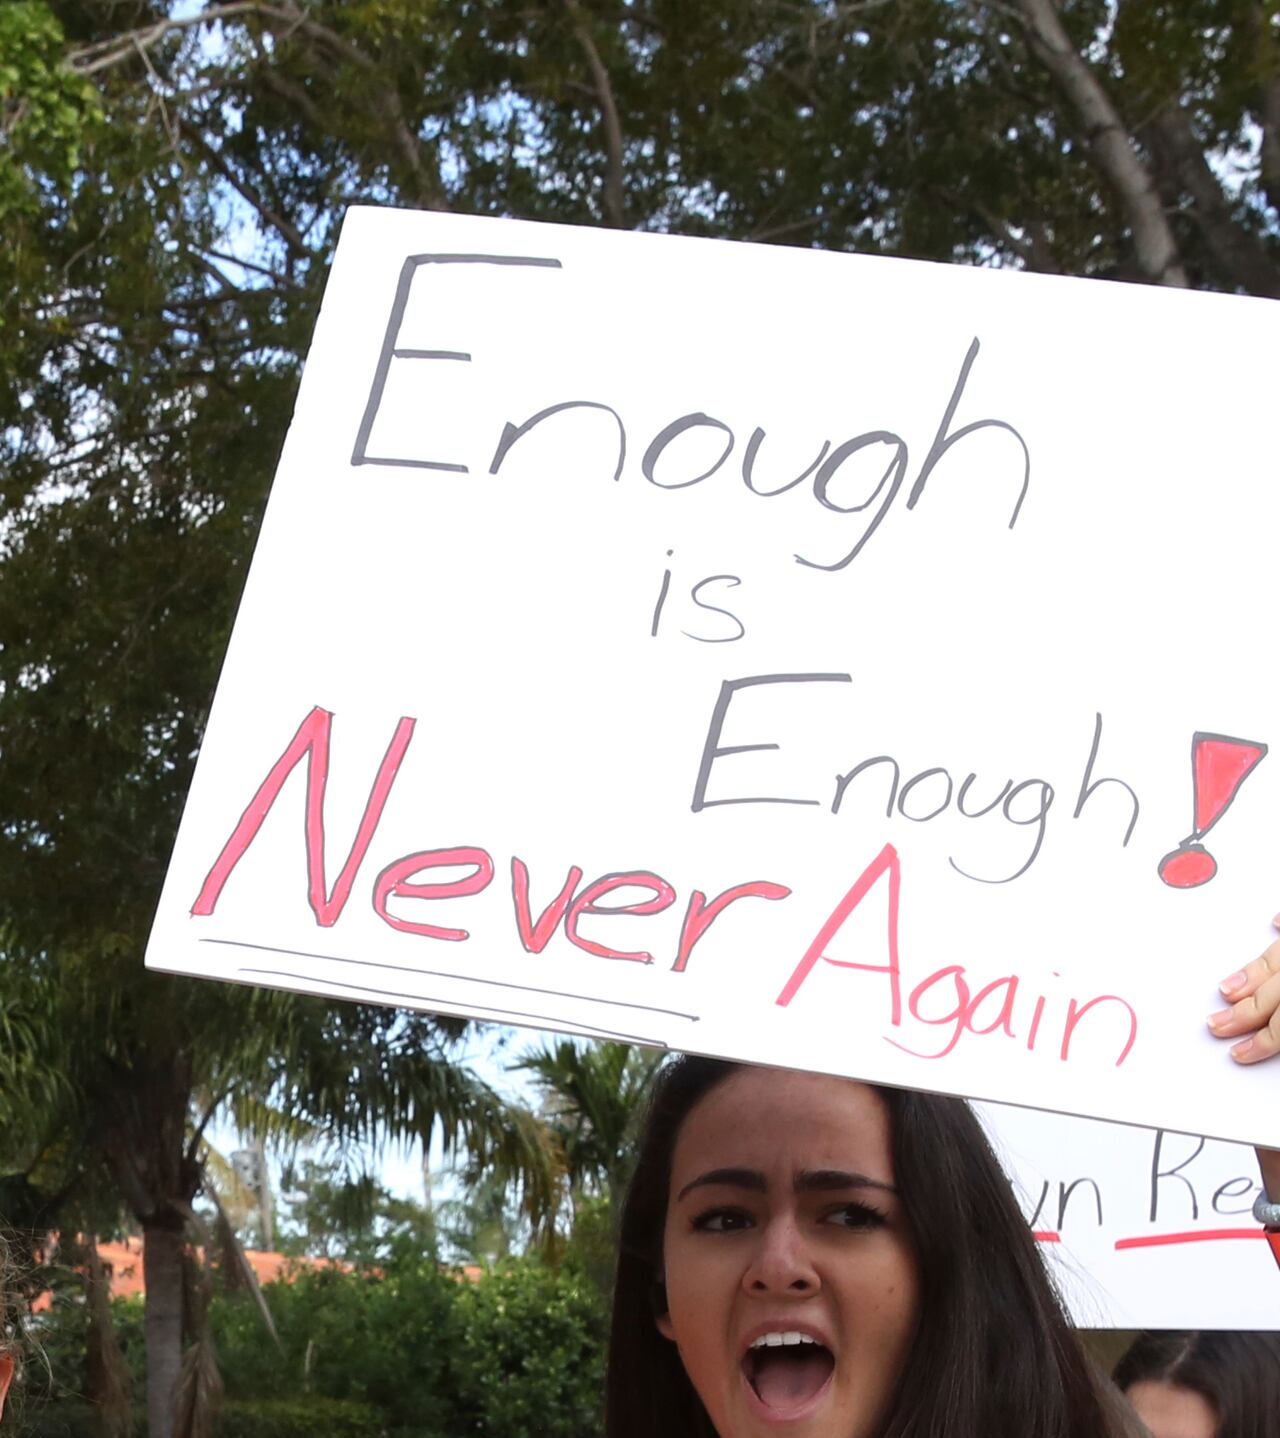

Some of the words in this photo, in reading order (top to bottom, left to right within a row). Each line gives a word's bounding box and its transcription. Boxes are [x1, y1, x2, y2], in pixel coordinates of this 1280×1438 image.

[352, 253, 1032, 571] Enough
[651, 547, 747, 642] is
[189, 705, 792, 973] Never
[775, 843, 1138, 1067] Again
